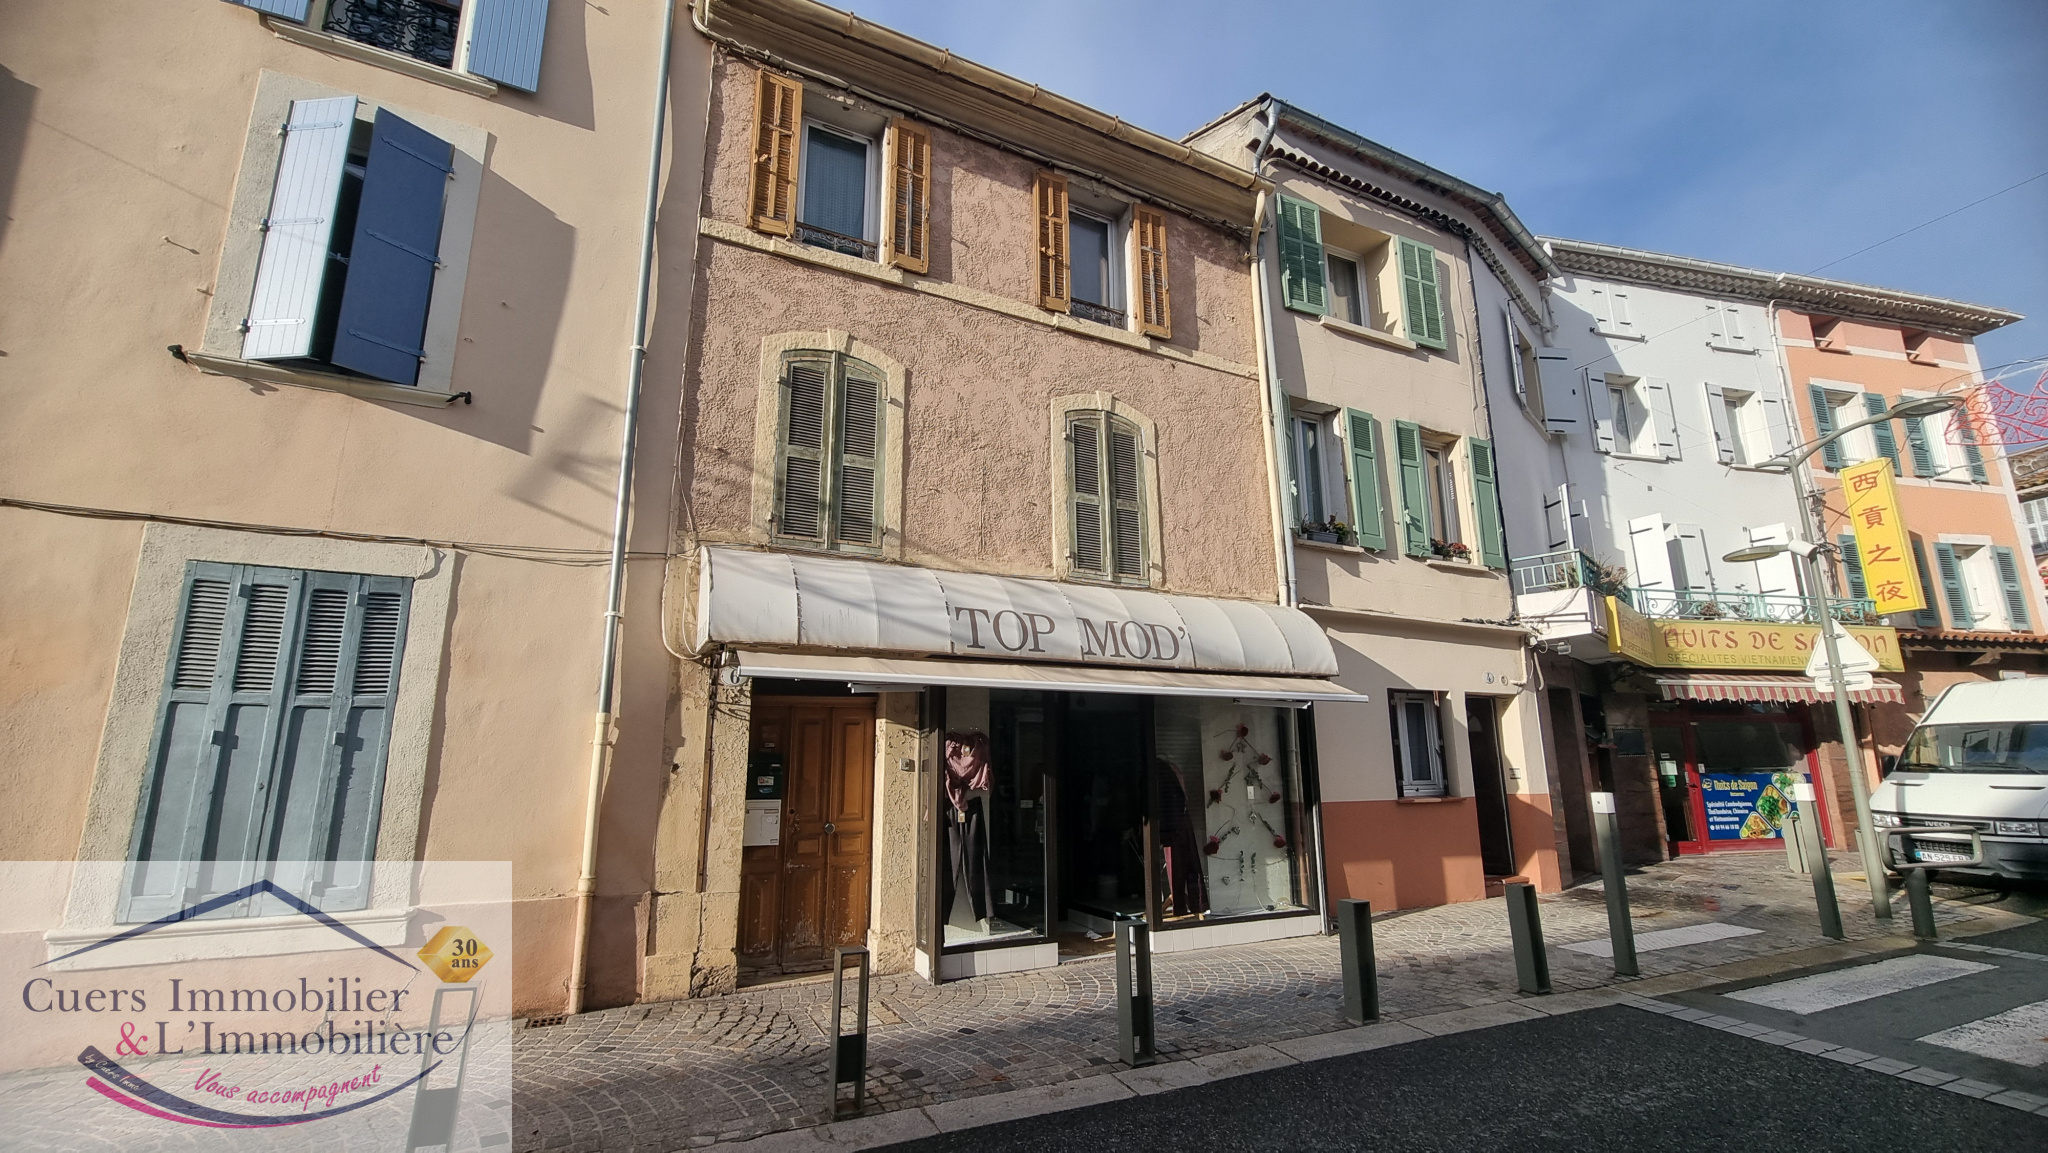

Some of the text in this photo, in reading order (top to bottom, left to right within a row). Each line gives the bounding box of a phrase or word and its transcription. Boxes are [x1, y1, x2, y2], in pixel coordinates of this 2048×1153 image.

[1849, 470, 1909, 602] 西貢之夜
[954, 606, 1186, 661] TOP MOD'
[1664, 628, 1739, 649] NUITS
[1748, 631, 1784, 651] DE
[1667, 652, 1737, 664] SPECIALITES
[730, 668, 740, 685] 6
[1924, 820, 1951, 828] IVECO
